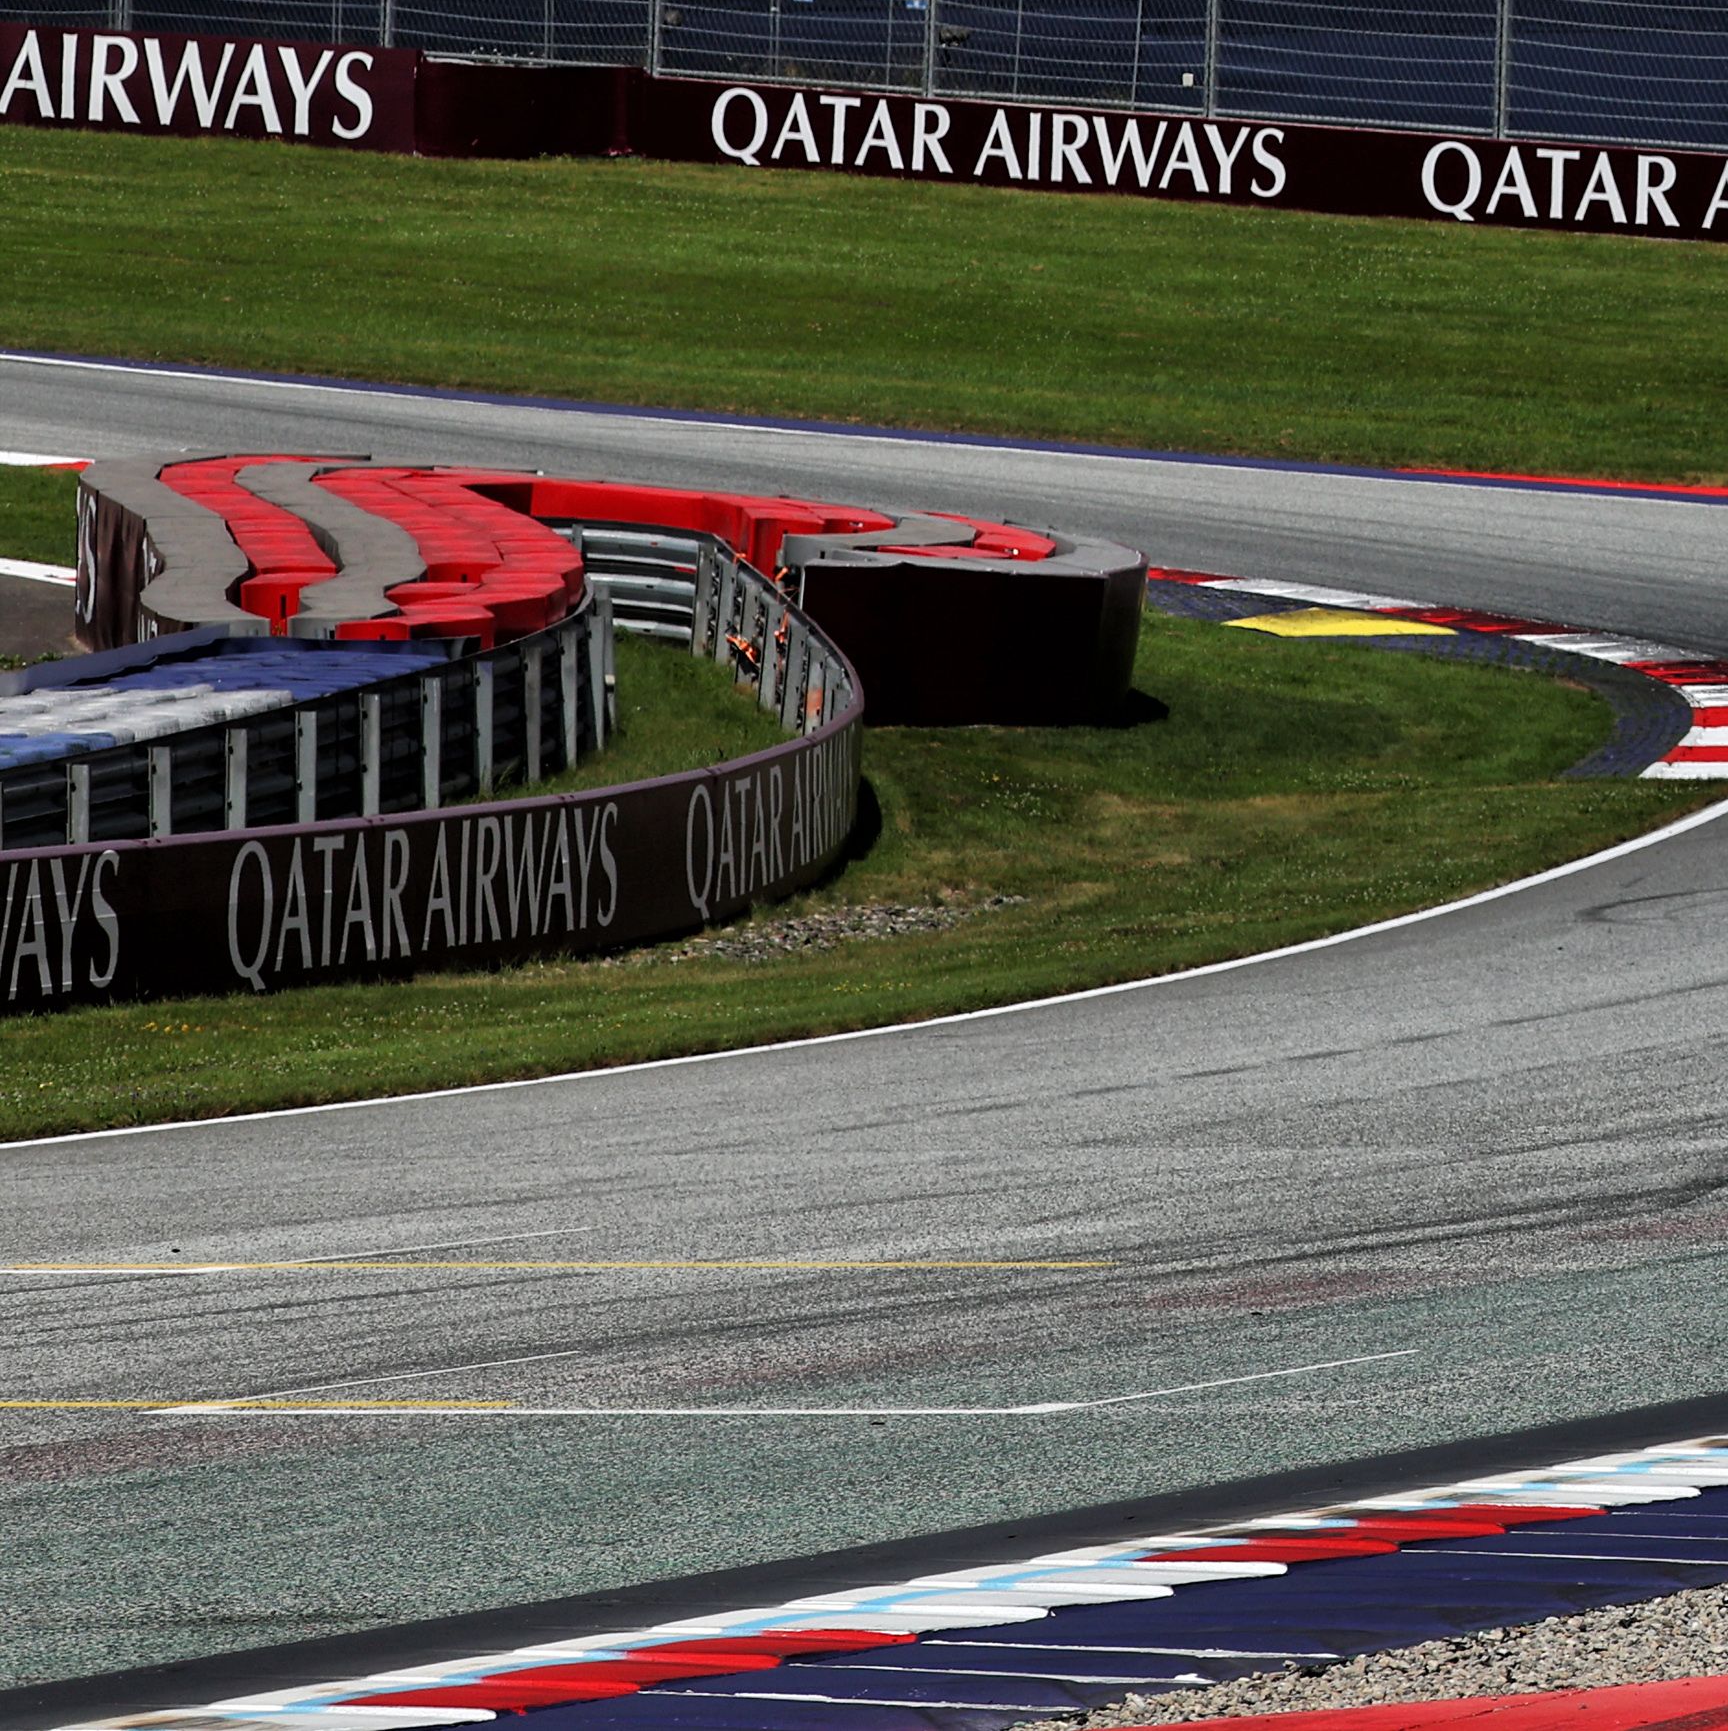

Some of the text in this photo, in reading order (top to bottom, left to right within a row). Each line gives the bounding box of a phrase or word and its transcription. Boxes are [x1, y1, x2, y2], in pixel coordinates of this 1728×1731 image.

[0, 30, 374, 140] AIRWAYS
[711, 87, 1286, 198] QATAR AIRWAYS
[1421, 140, 1680, 227] QATAR
[228, 829, 411, 990] QATAR
[421, 802, 617, 951] AIRWAYS
[686, 764, 784, 920] QATAR
